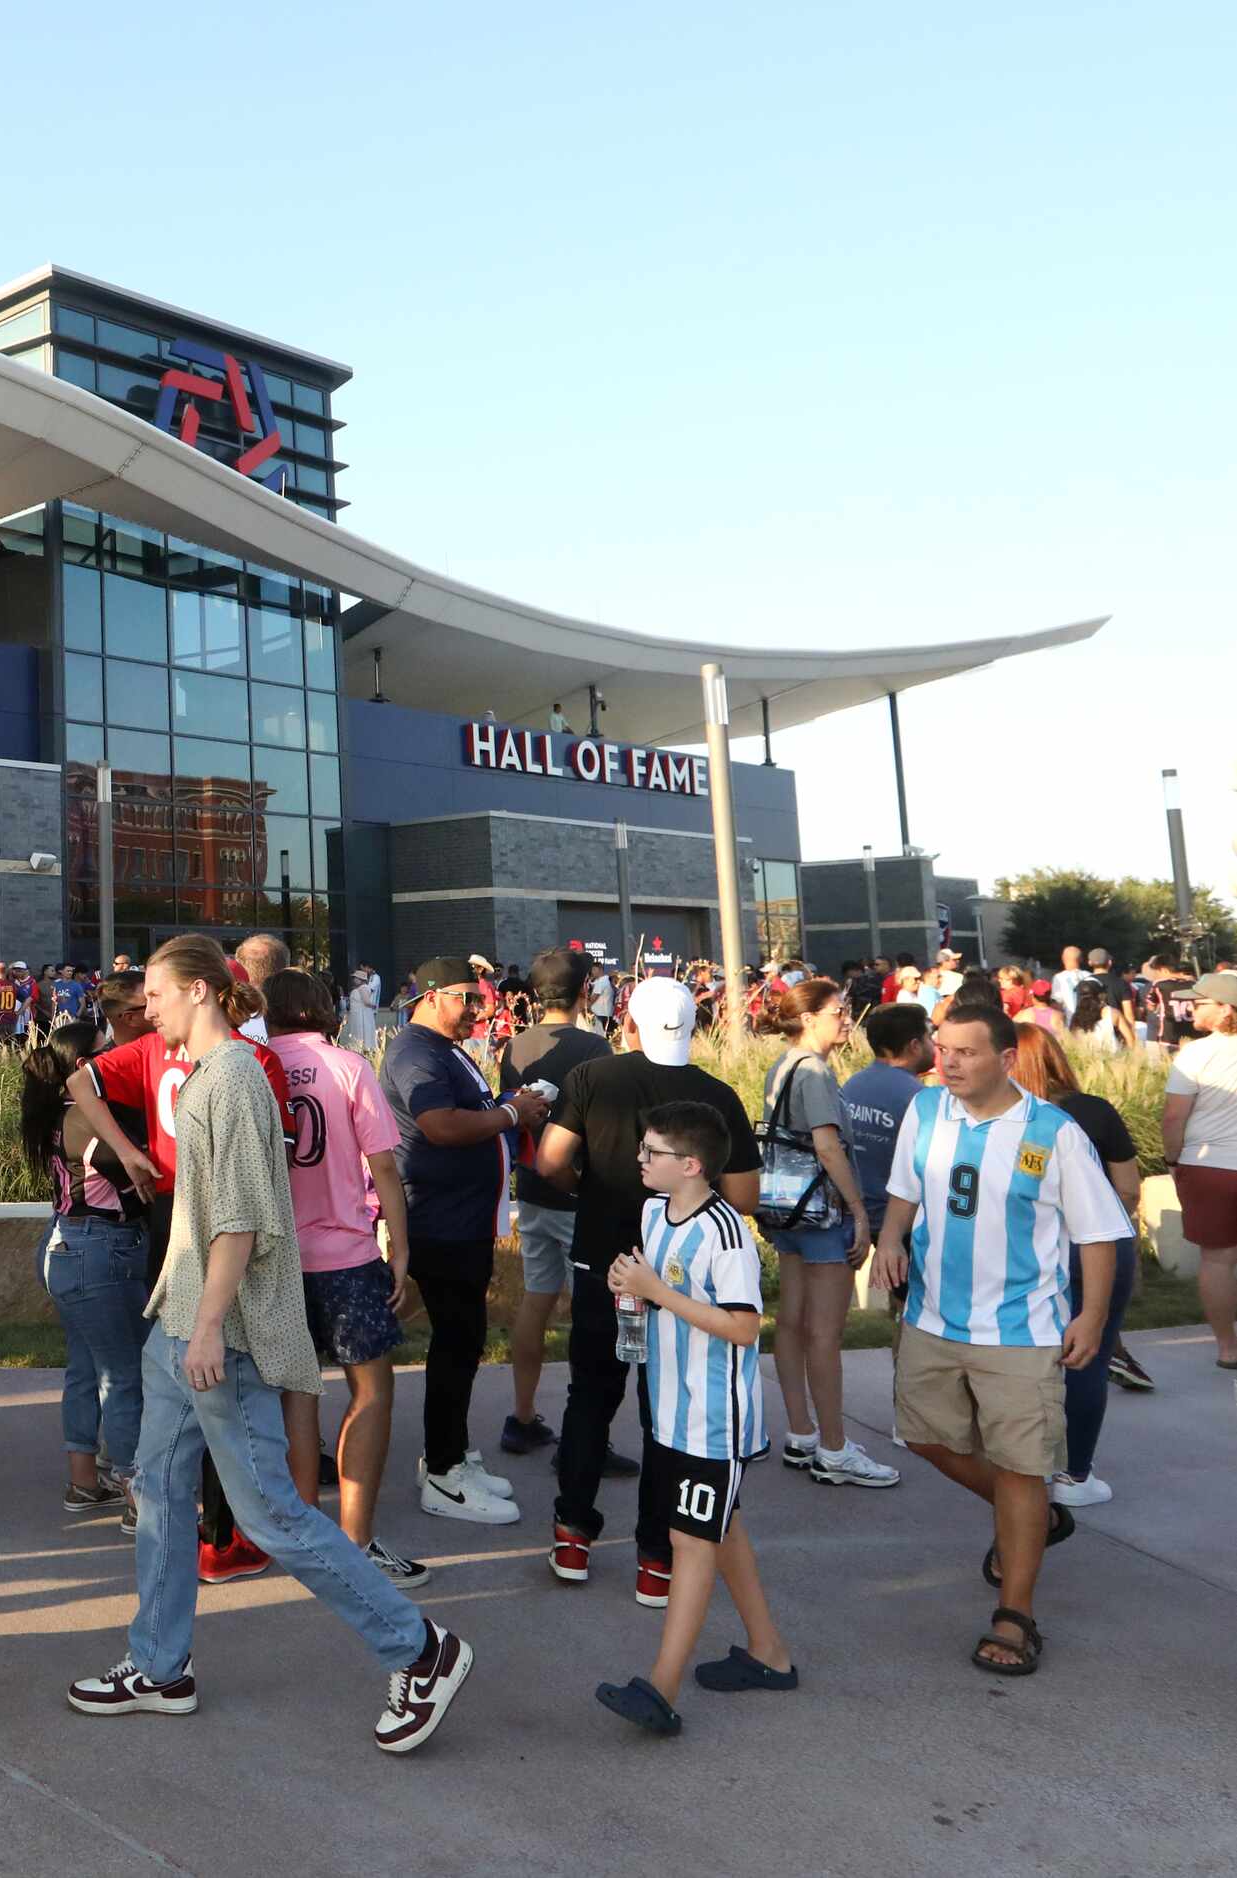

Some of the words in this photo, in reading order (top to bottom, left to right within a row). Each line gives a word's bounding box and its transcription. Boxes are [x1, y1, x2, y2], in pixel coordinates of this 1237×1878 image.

[468, 722, 563, 777] HALL
[572, 740, 618, 783] OF
[628, 748, 709, 796] FAME
[585, 942, 607, 950] NATIONAL
[0, 991, 14, 1010] 10
[848, 1103, 894, 1128] SAINTS
[947, 1162, 980, 1220] 9
[676, 1478, 716, 1522] 10
